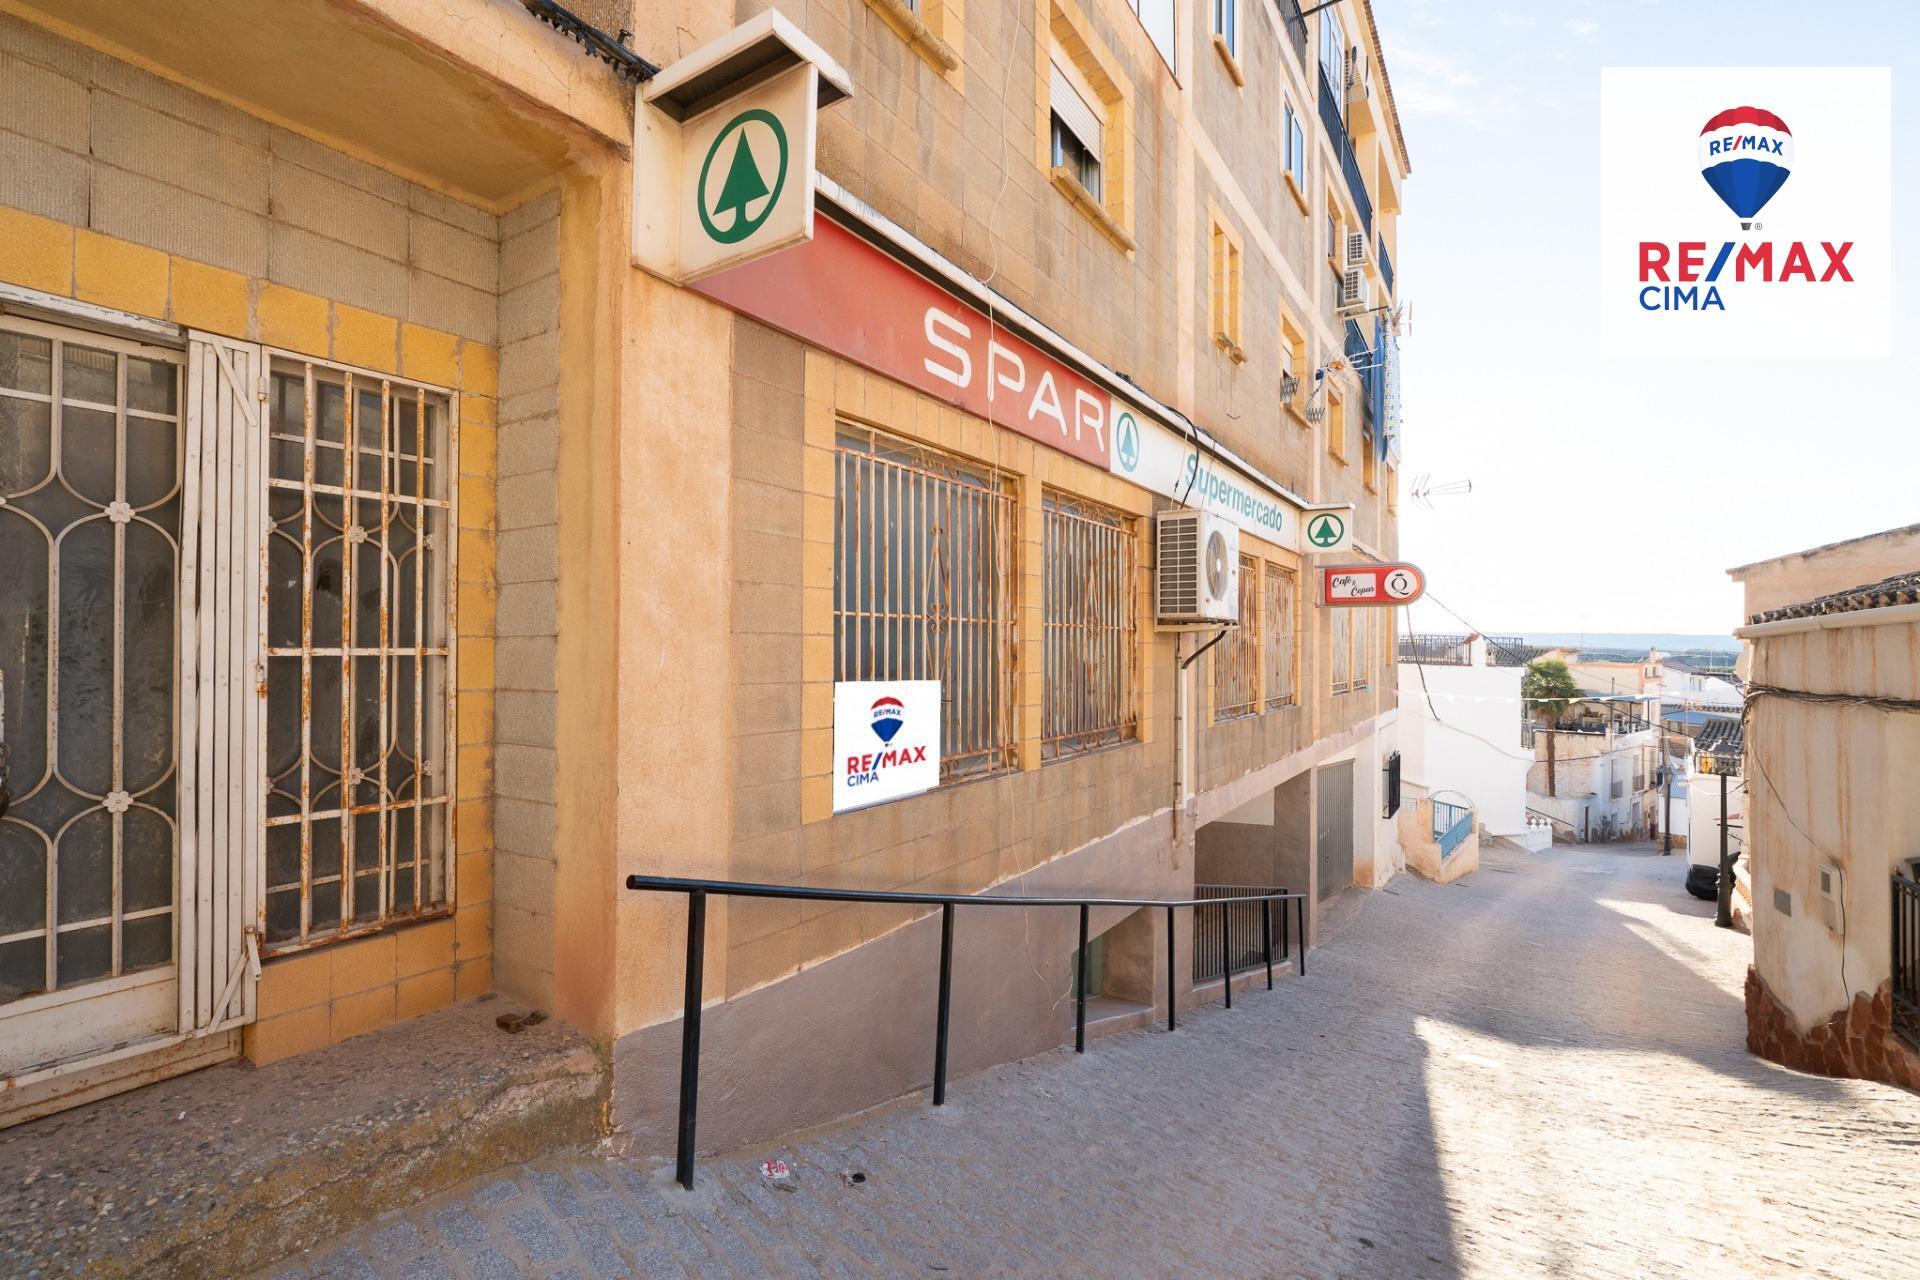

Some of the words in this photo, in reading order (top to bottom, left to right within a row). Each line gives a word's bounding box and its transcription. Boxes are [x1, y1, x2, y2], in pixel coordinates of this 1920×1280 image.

[924, 306, 1105, 453] SPAR
[1184, 453, 1283, 532] Supermercado
[1391, 577, 1409, 595] Q
[873, 708, 901, 718] RE/MAX
[847, 745, 926, 775] RE/MAX
[847, 771, 879, 787] CIMA
